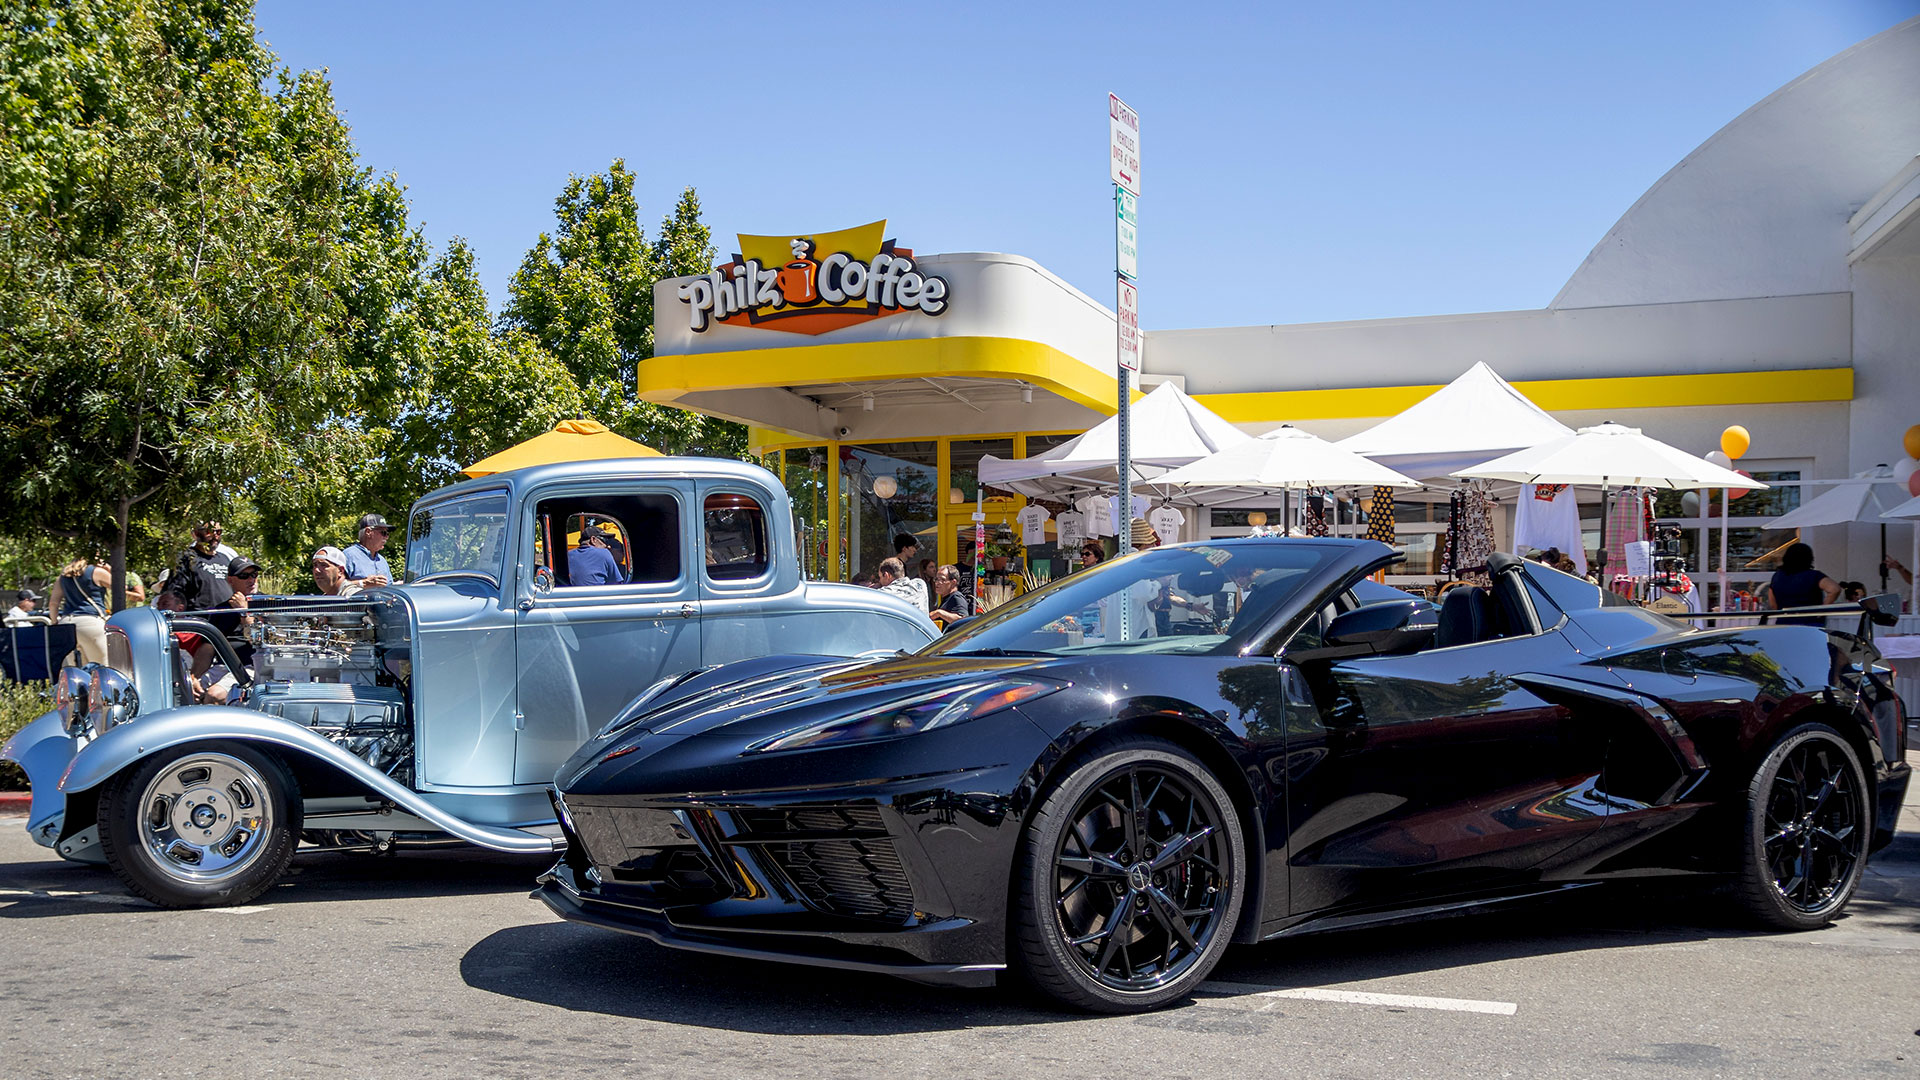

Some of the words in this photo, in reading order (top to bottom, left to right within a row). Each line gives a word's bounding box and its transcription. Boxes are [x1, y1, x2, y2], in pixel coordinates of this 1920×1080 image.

[1119, 104, 1138, 132] PARKING
[1116, 129, 1135, 153] VEHICLES
[1113, 145, 1123, 163] OVER
[1118, 192, 1124, 214] 2
[817, 252, 951, 317] Coffee
[1123, 289, 1132, 307] NO
[1119, 306, 1137, 328] PARKING
